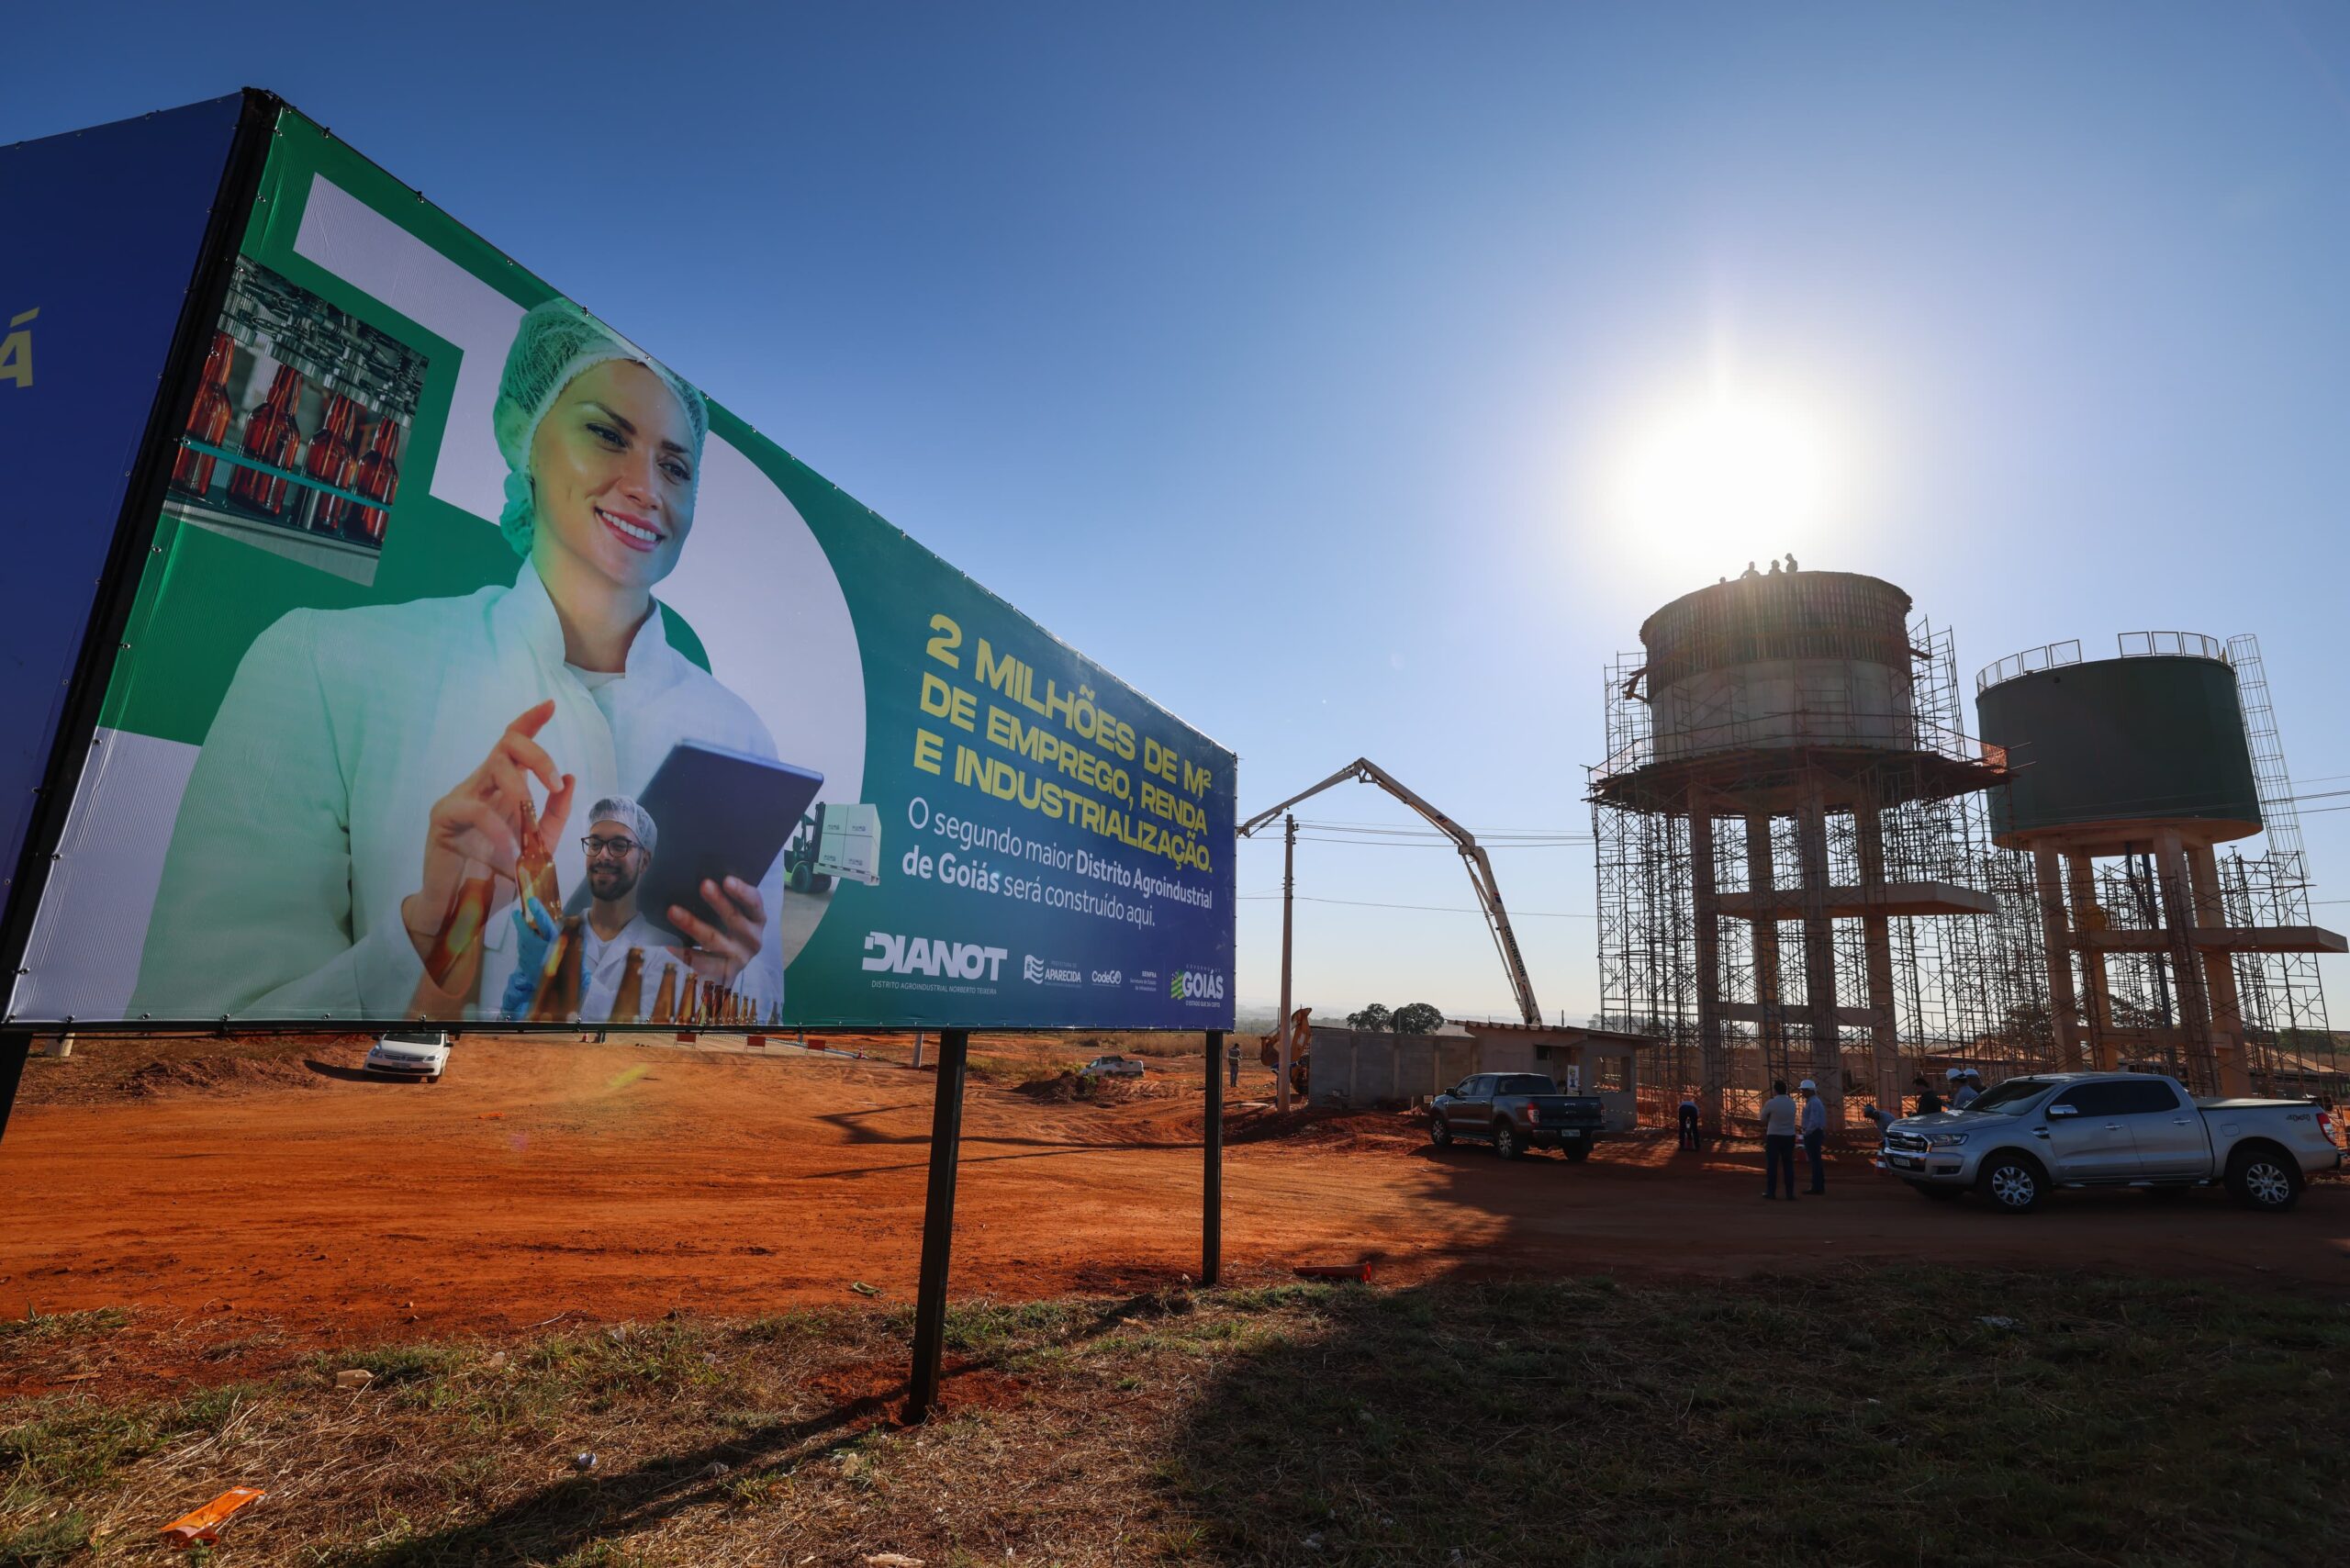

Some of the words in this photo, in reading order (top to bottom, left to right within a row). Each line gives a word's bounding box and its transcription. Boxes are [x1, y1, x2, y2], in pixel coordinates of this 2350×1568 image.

[925, 613, 963, 669] 2
[975, 637, 1136, 761] MILHÕES
[1144, 736, 1179, 784] DE
[1183, 759, 1212, 799] M²
[920, 671, 978, 733] DE
[986, 704, 1134, 812] EMPREGO,
[1141, 780, 1208, 836] RENDA
[913, 728, 945, 776] E
[954, 744, 1214, 873] INDUSTRIALIZAÇÃO.
[908, 796, 929, 830] O
[934, 812, 1023, 857] segundo
[1025, 841, 1074, 872] maior
[1076, 848, 1131, 888] Distrito
[1133, 868, 1213, 909] Agroindustrial
[901, 845, 934, 879] de
[938, 852, 1001, 894] Goiás
[1002, 875, 1042, 903] será
[1045, 885, 1125, 921] construído
[1126, 905, 1156, 931] aqui.
[861, 931, 1008, 981] DIANOT
[1044, 969, 1081, 983] APARECIDA
[1091, 969, 1122, 985] CodeGO
[1504, 925, 1527, 978] CONCRECON
[871, 980, 900, 989] DISTRITO
[900, 981, 948, 992] AGROINDUSTRIAL
[1182, 969, 1224, 1000] GOIÁS
